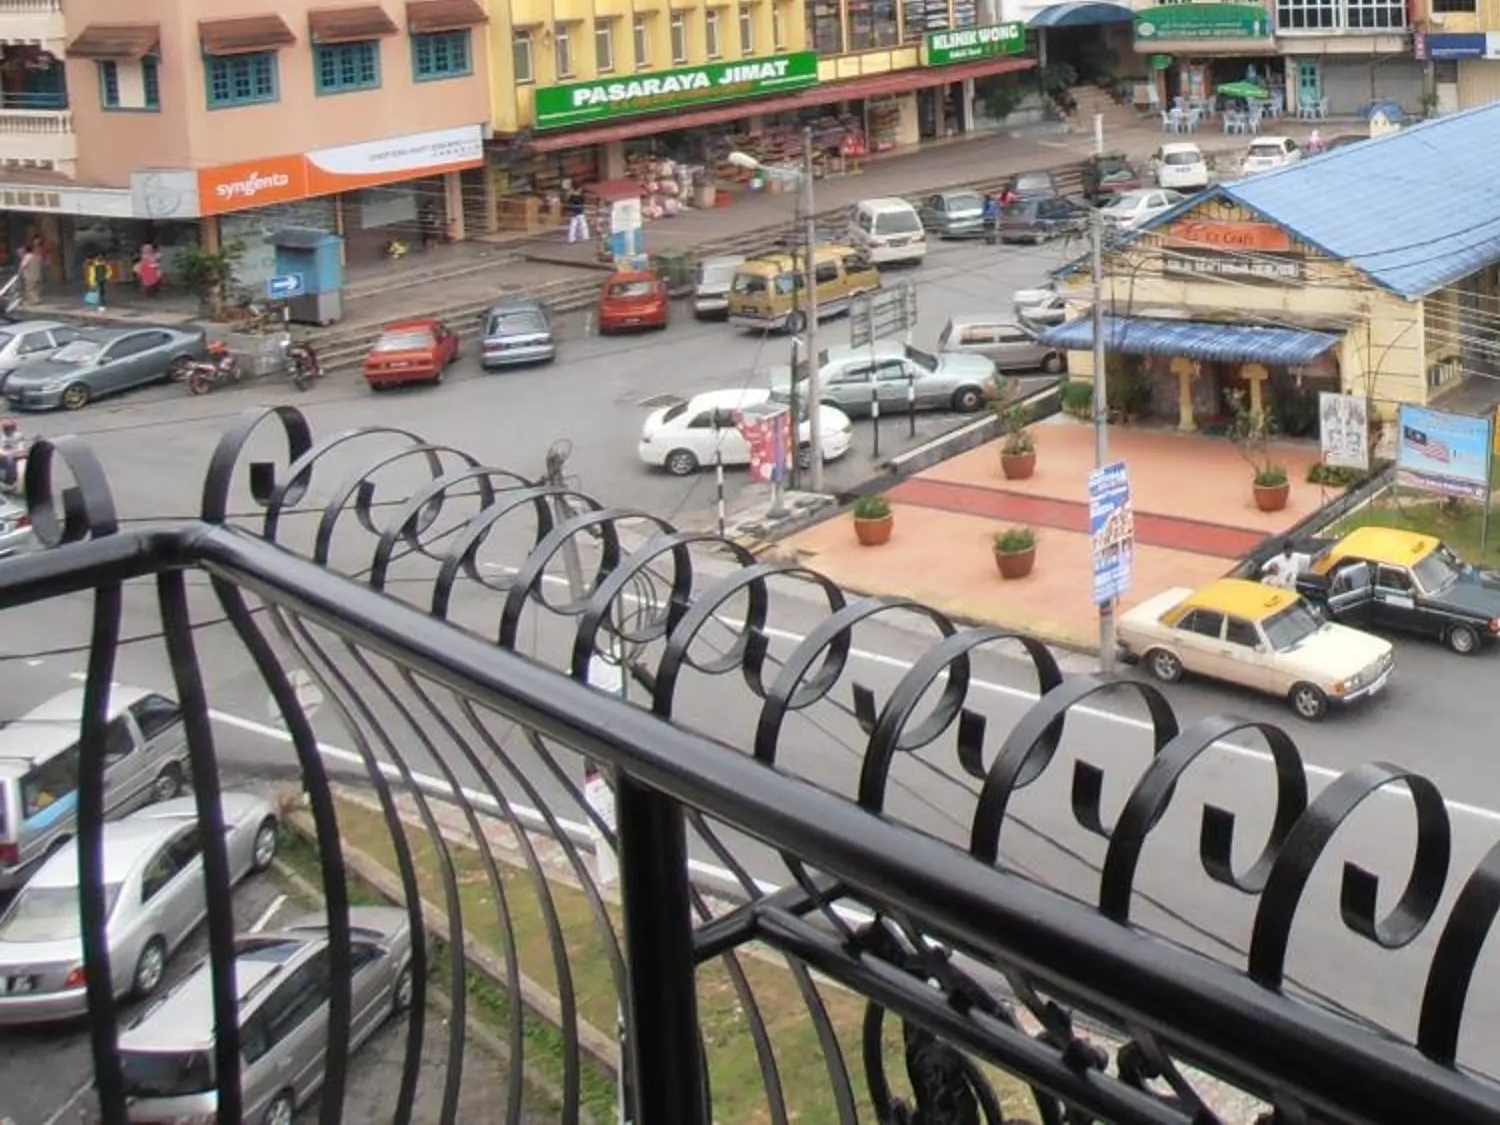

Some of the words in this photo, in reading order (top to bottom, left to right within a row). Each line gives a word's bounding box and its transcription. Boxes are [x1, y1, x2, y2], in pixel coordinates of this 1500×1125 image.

[932, 31, 977, 50] KLINIK
[978, 24, 1019, 43] WONG
[572, 72, 709, 107] PASARAYA
[718, 60, 788, 85] JIMAT
[215, 171, 289, 200] syngenta
